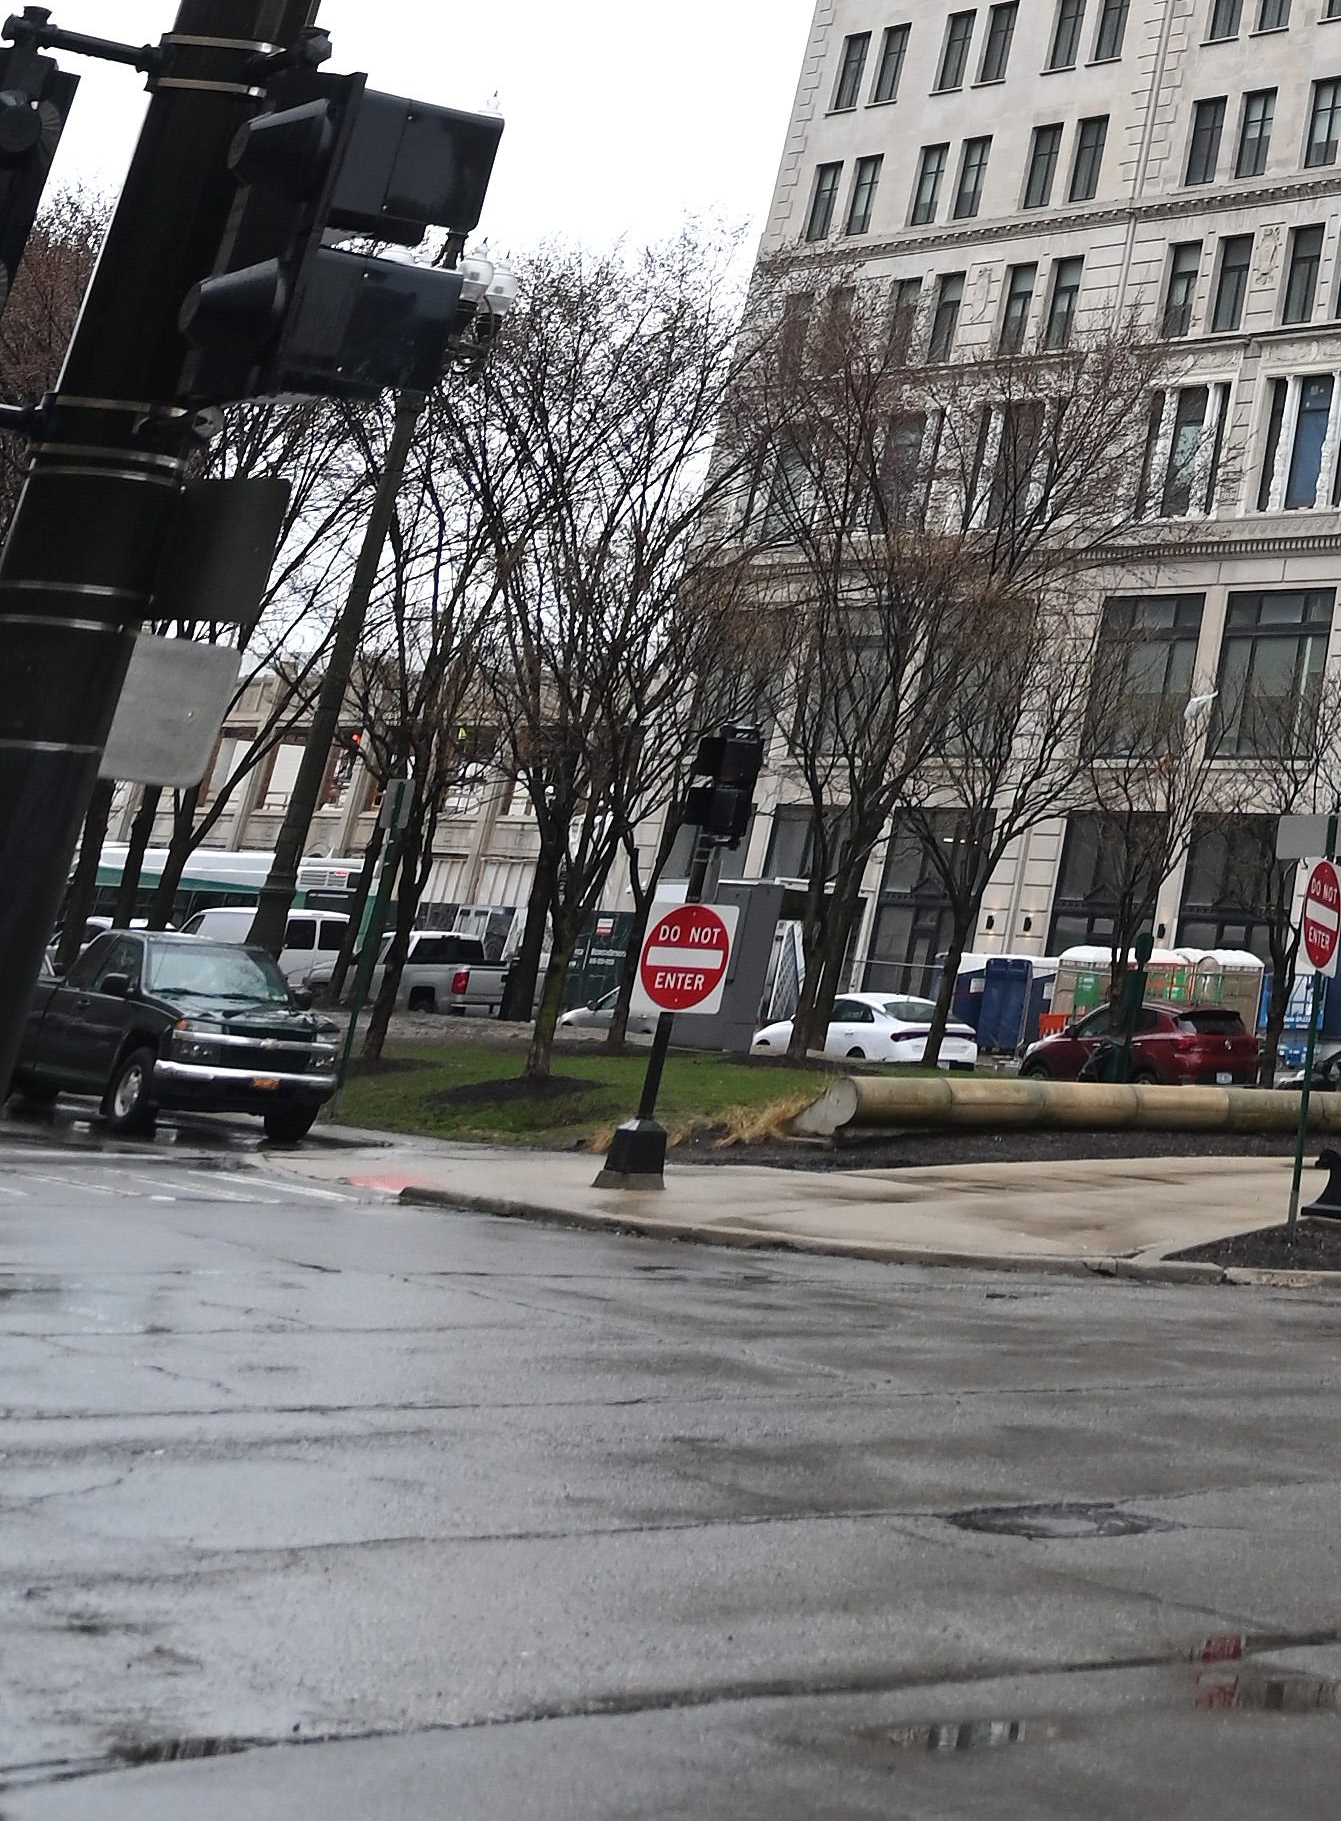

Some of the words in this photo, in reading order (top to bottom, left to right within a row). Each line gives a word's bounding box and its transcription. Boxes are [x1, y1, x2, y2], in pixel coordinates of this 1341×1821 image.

[1310, 877, 1322, 896] DO
[1323, 883, 1338, 905] NOT
[658, 924, 681, 942] DO
[689, 926, 721, 945] NOT
[1308, 925, 1331, 952] ENTER
[654, 971, 705, 991] ENTER
